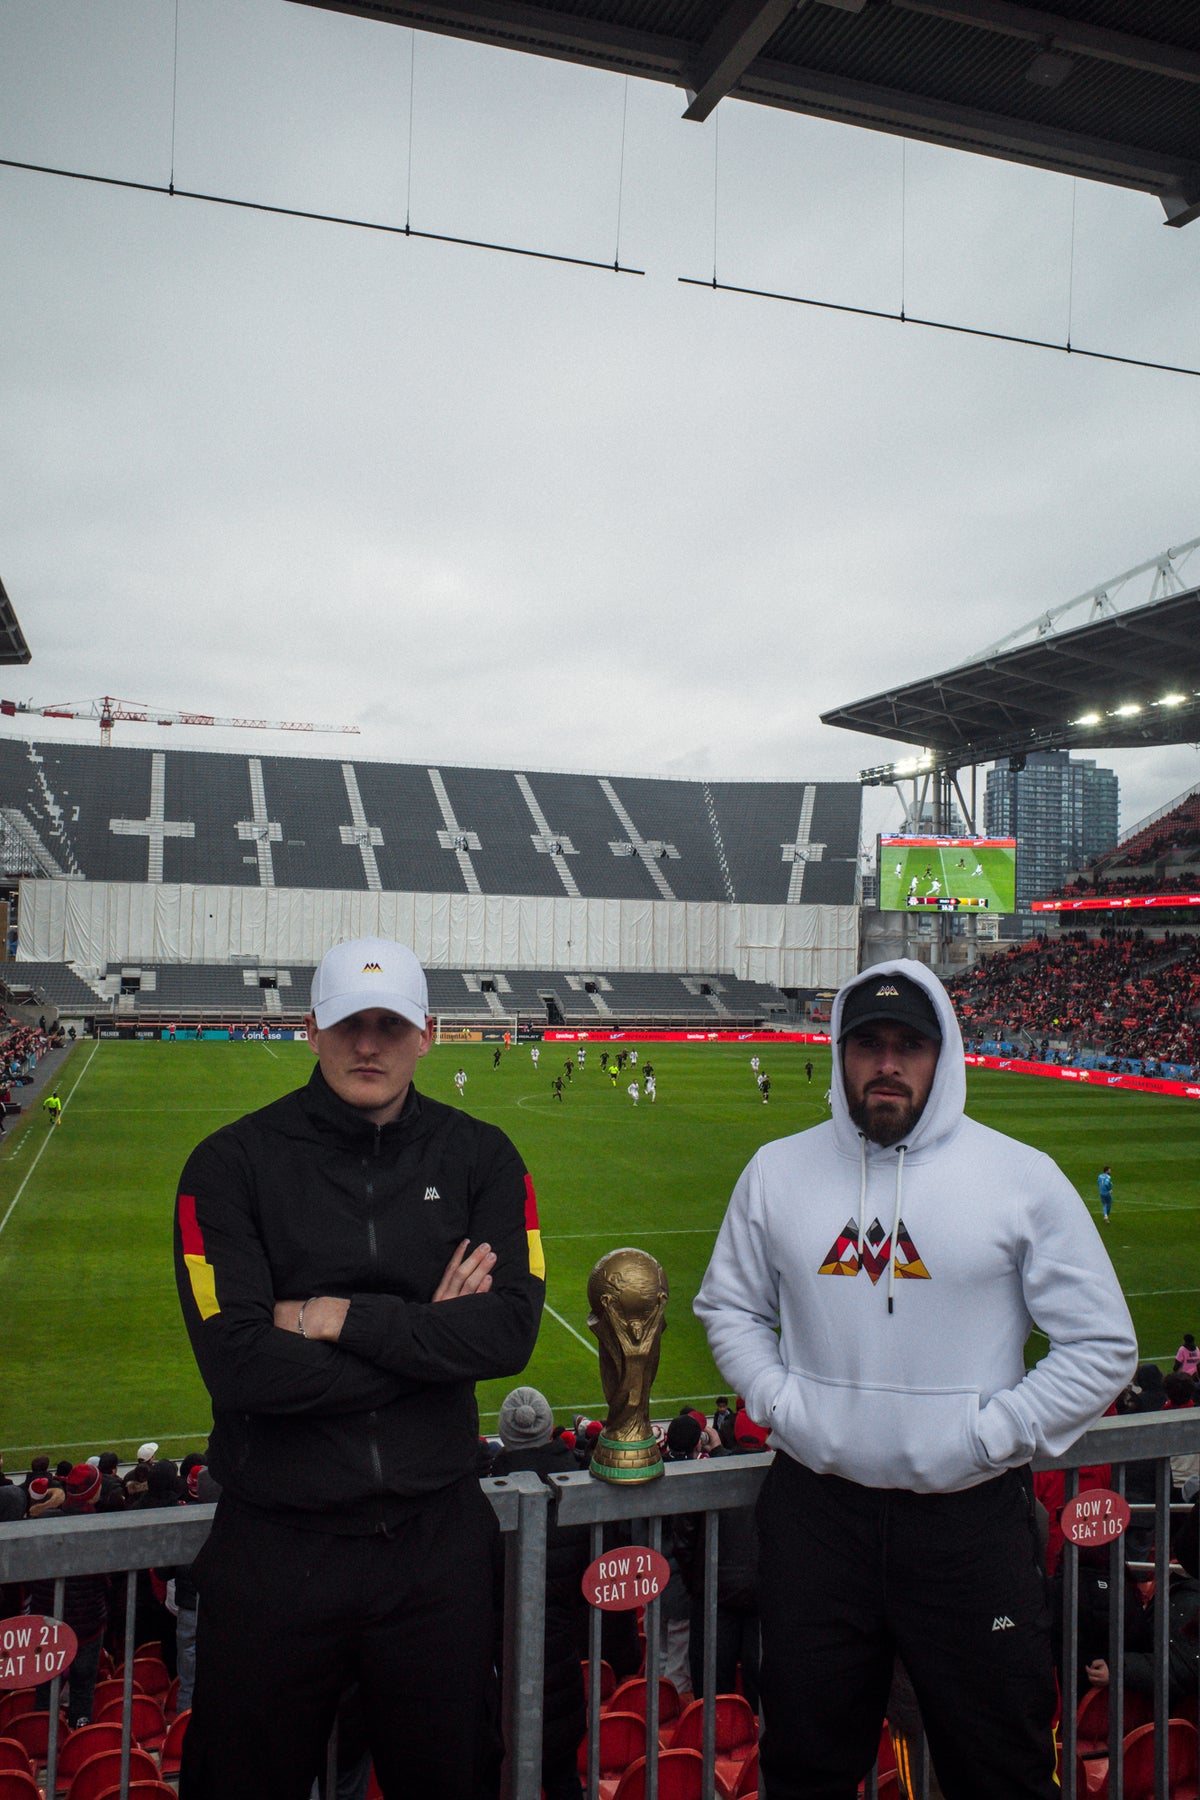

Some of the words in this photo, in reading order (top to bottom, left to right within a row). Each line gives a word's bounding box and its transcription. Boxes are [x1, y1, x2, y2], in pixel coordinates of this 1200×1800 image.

[1076, 1500, 1101, 1518] ROW
[1105, 1498, 1112, 1514] 2
[1072, 1521, 1098, 1540] SEAT
[1102, 1518, 1123, 1535] 105
[599, 1558, 630, 1579] ROW
[636, 1554, 651, 1573] 21
[594, 1582, 627, 1604] SEAT
[633, 1577, 659, 1597] 106
[0, 1628, 32, 1650] OW
[39, 1625, 58, 1646] 21
[0, 1655, 26, 1678] EAT
[35, 1650, 66, 1673] 107
